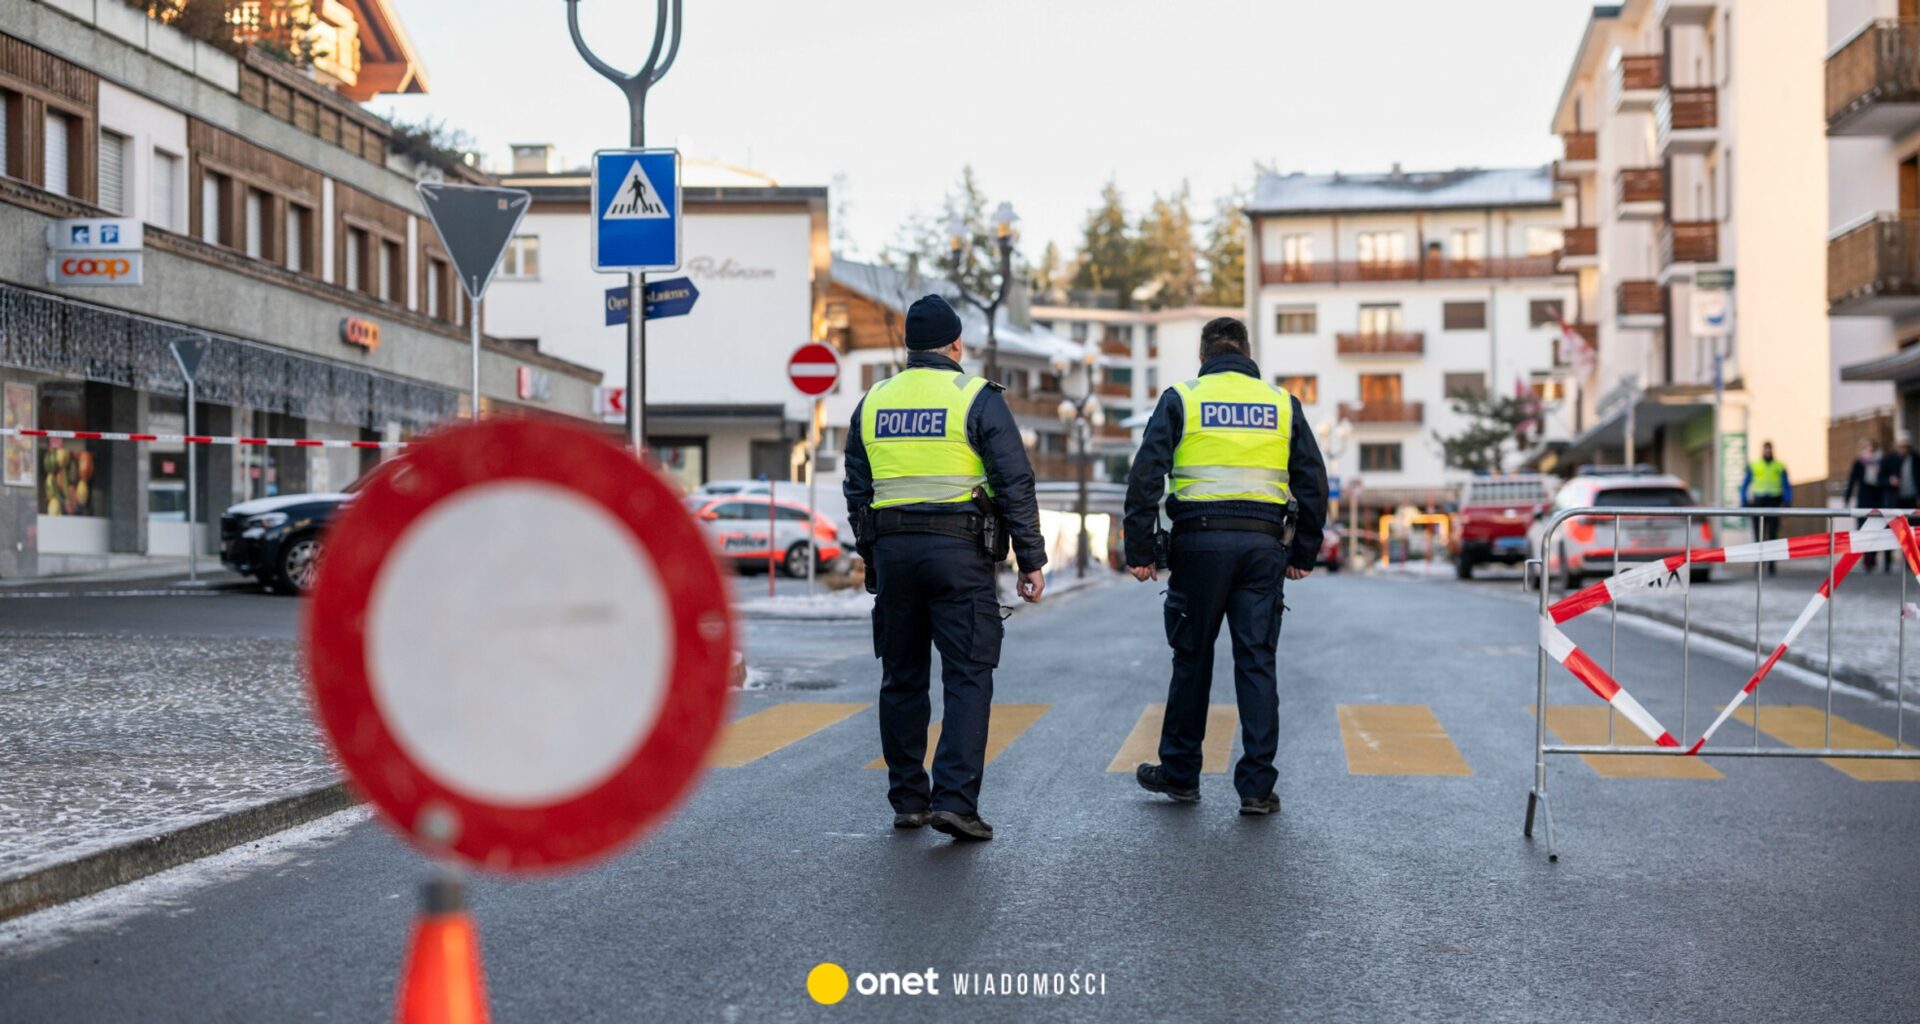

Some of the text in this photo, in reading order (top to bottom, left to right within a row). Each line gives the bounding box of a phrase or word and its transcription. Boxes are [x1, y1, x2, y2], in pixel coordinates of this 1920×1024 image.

[61, 258, 131, 281] coop
[877, 412, 944, 434] POLICE
[1203, 404, 1275, 427] POLICE
